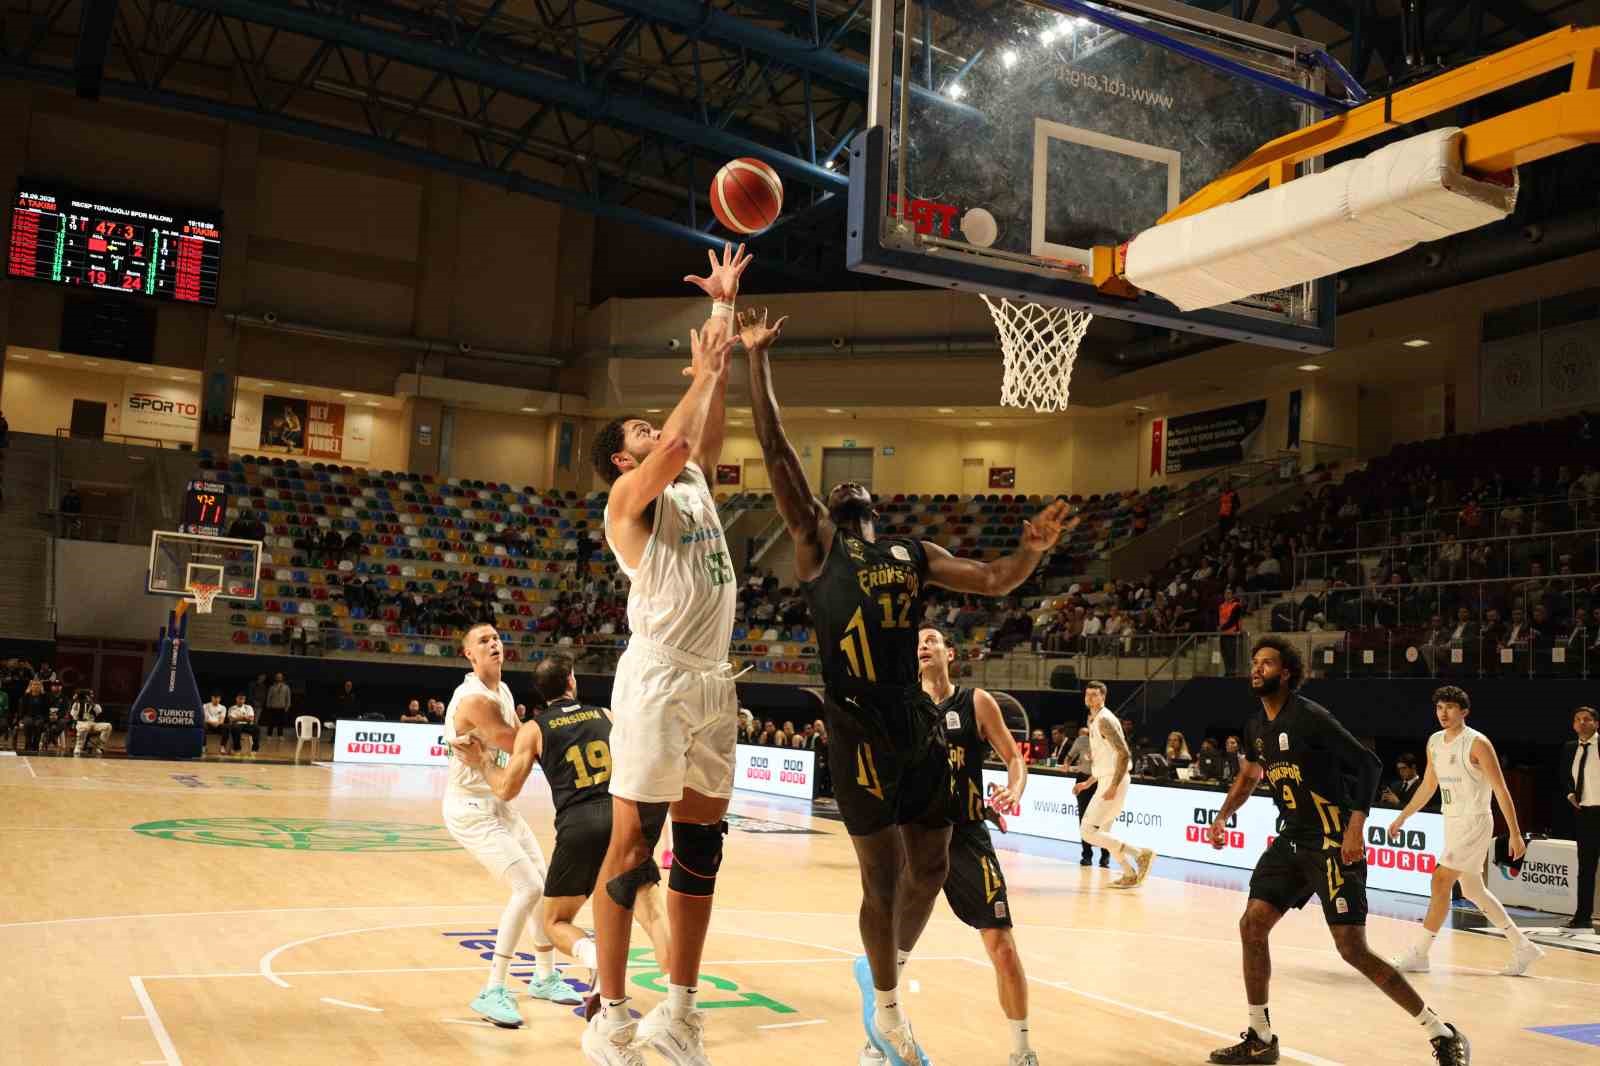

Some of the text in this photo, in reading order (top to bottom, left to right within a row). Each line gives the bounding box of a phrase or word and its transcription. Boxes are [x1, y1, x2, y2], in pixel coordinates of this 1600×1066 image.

[130, 210, 148, 219] SPOR
[134, 246, 143, 257] 2
[87, 270, 107, 285] 19
[122, 275, 142, 289] 24
[878, 592, 912, 629] 12
[564, 740, 613, 789] 19
[1282, 785, 1297, 809] 9
